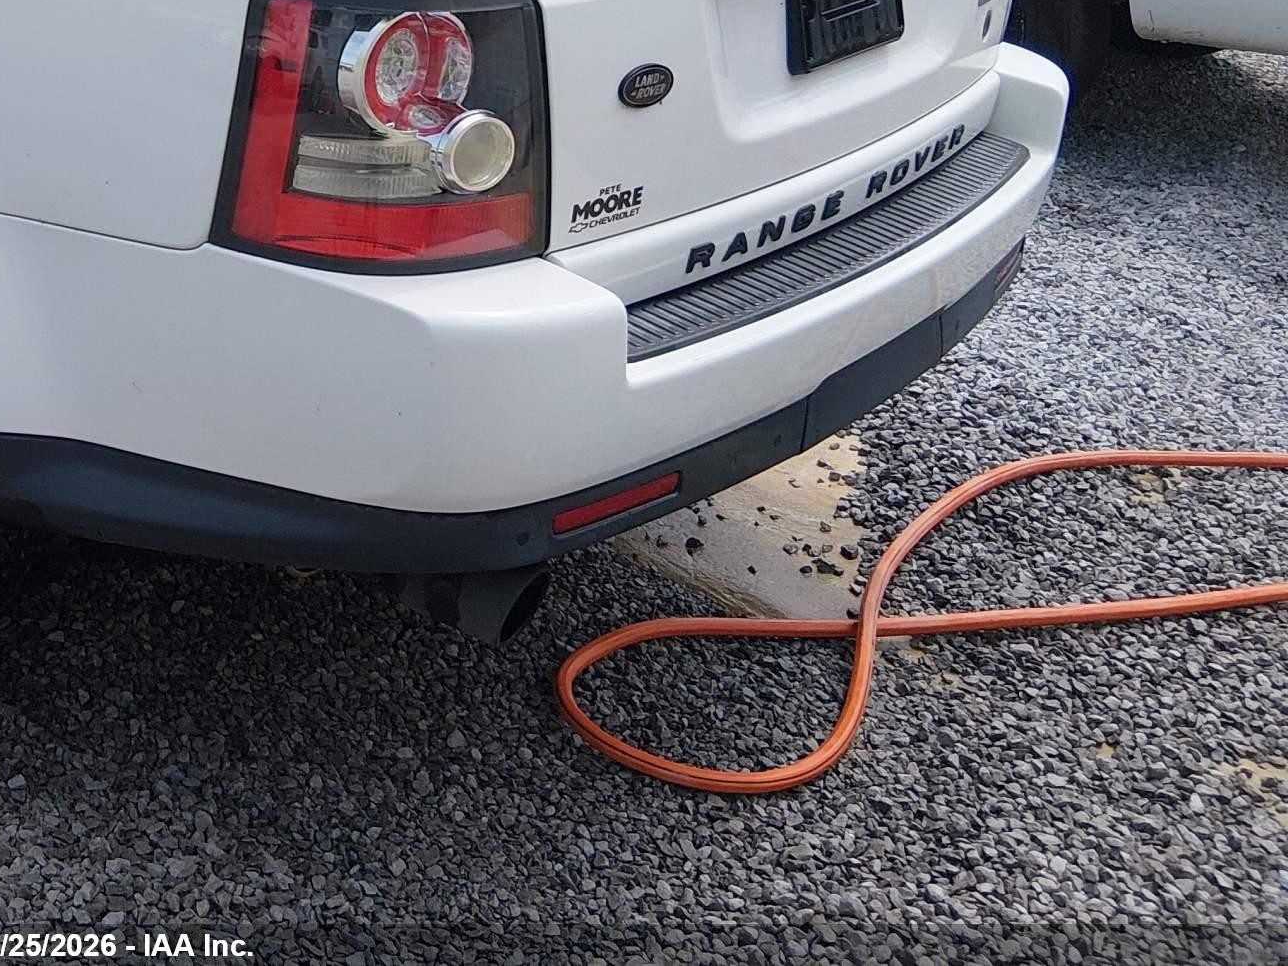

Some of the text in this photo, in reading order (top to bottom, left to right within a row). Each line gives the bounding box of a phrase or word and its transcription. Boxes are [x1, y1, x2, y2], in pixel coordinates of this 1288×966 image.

[635, 73, 660, 87] LAND
[635, 83, 666, 99] ROVER
[599, 183, 622, 196] PETE
[571, 186, 644, 223] MOORE
[684, 124, 965, 274] RANGE ROVER
[589, 207, 641, 228] CHEVROLET
